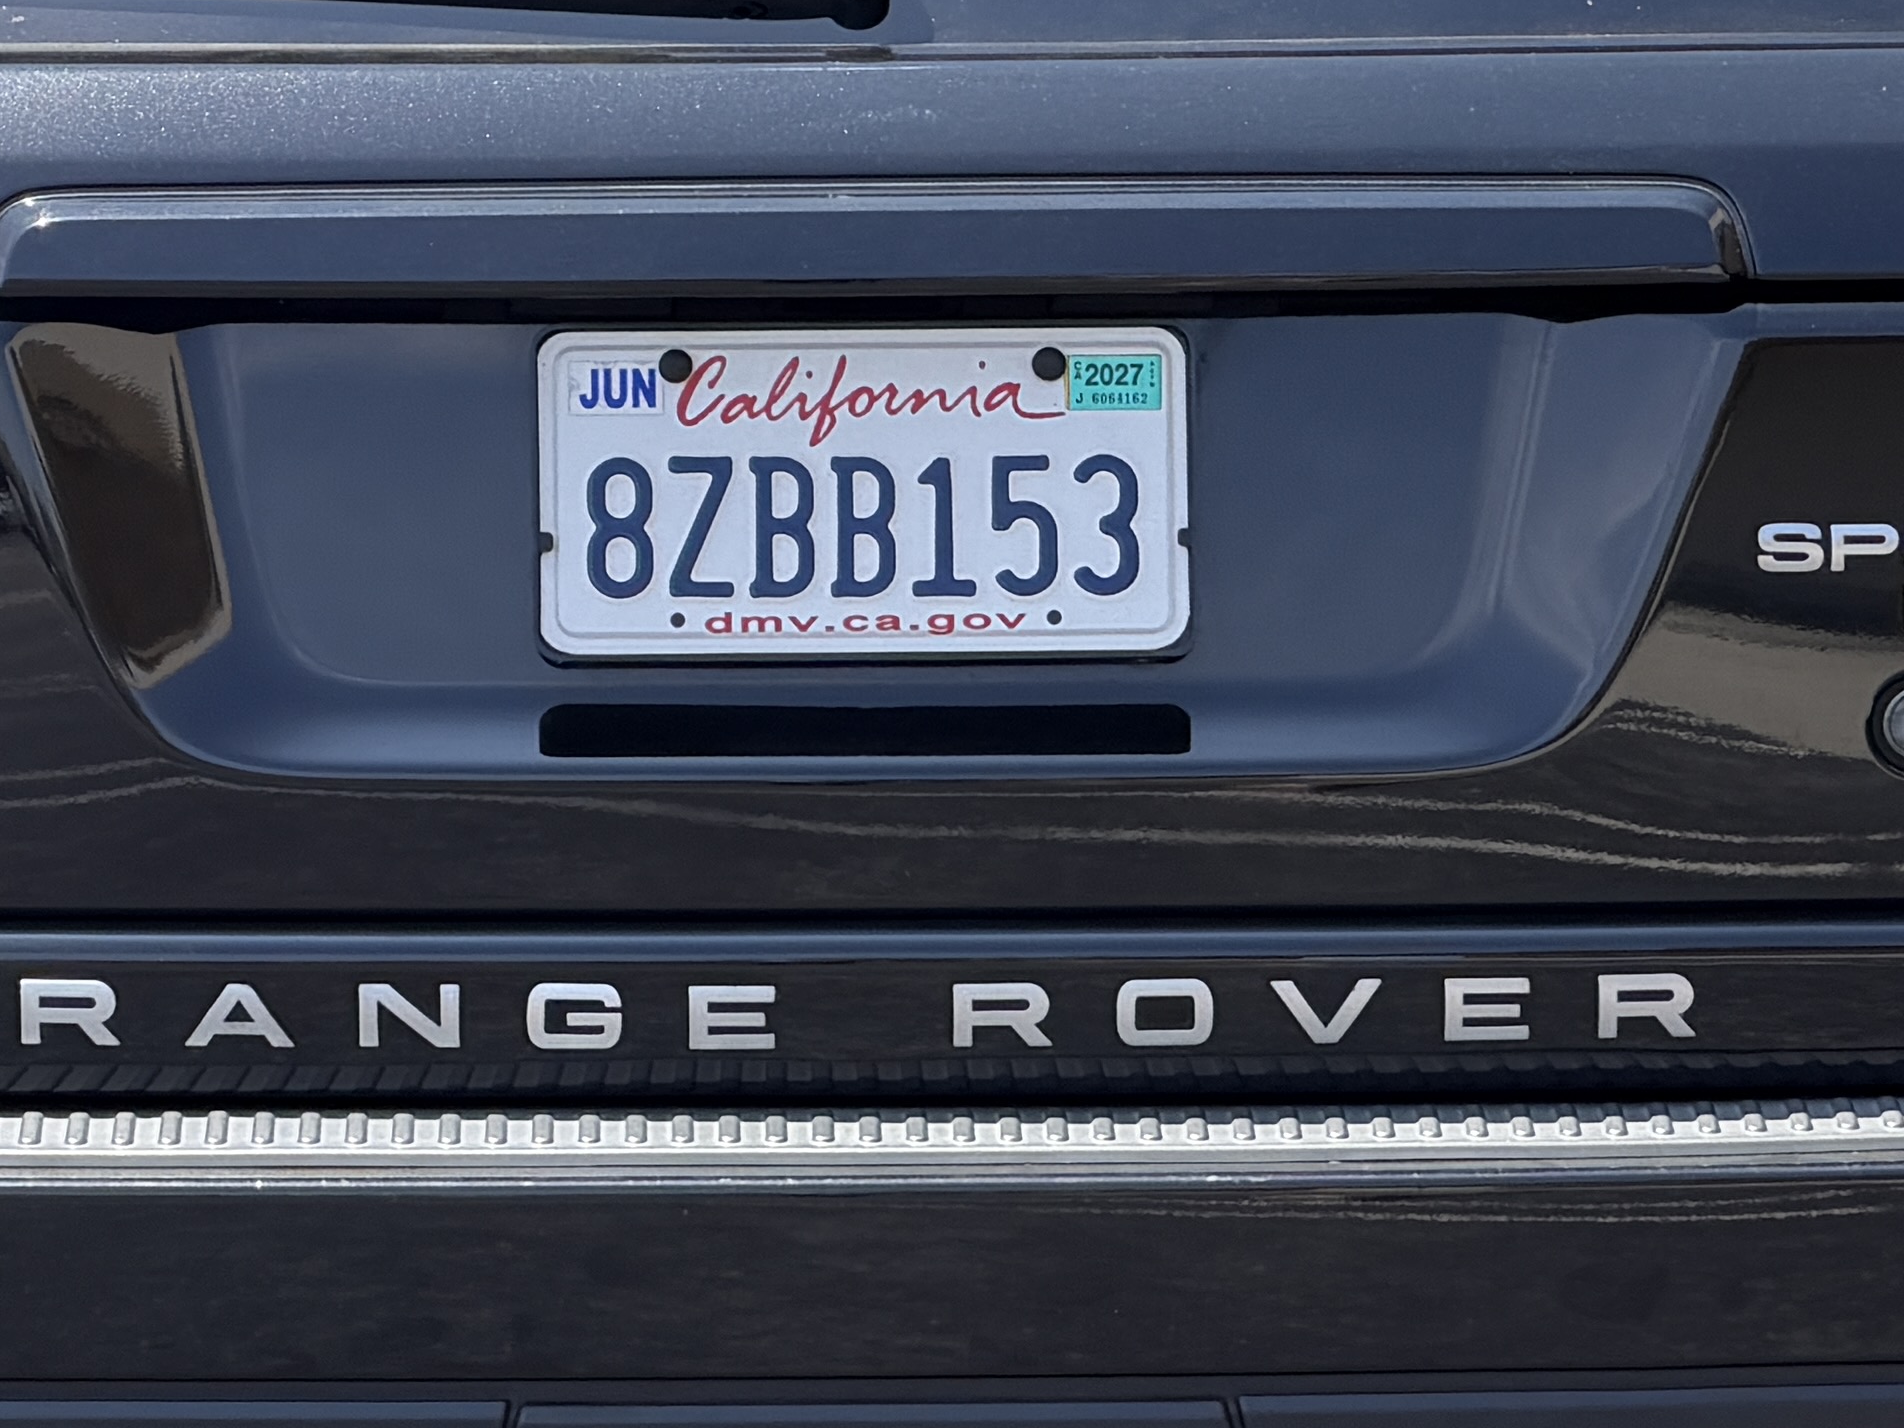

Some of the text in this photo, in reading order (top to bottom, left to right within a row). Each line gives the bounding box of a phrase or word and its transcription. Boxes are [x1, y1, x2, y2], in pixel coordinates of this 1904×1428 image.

[579, 368, 657, 410] JUN
[676, 354, 1066, 447] California
[1084, 363, 1144, 387] 2027
[586, 454, 1140, 600] 8ZBB153
[704, 612, 1027, 636] dmv.ca.gov
[19, 972, 1696, 1051] RANGE ROVER
